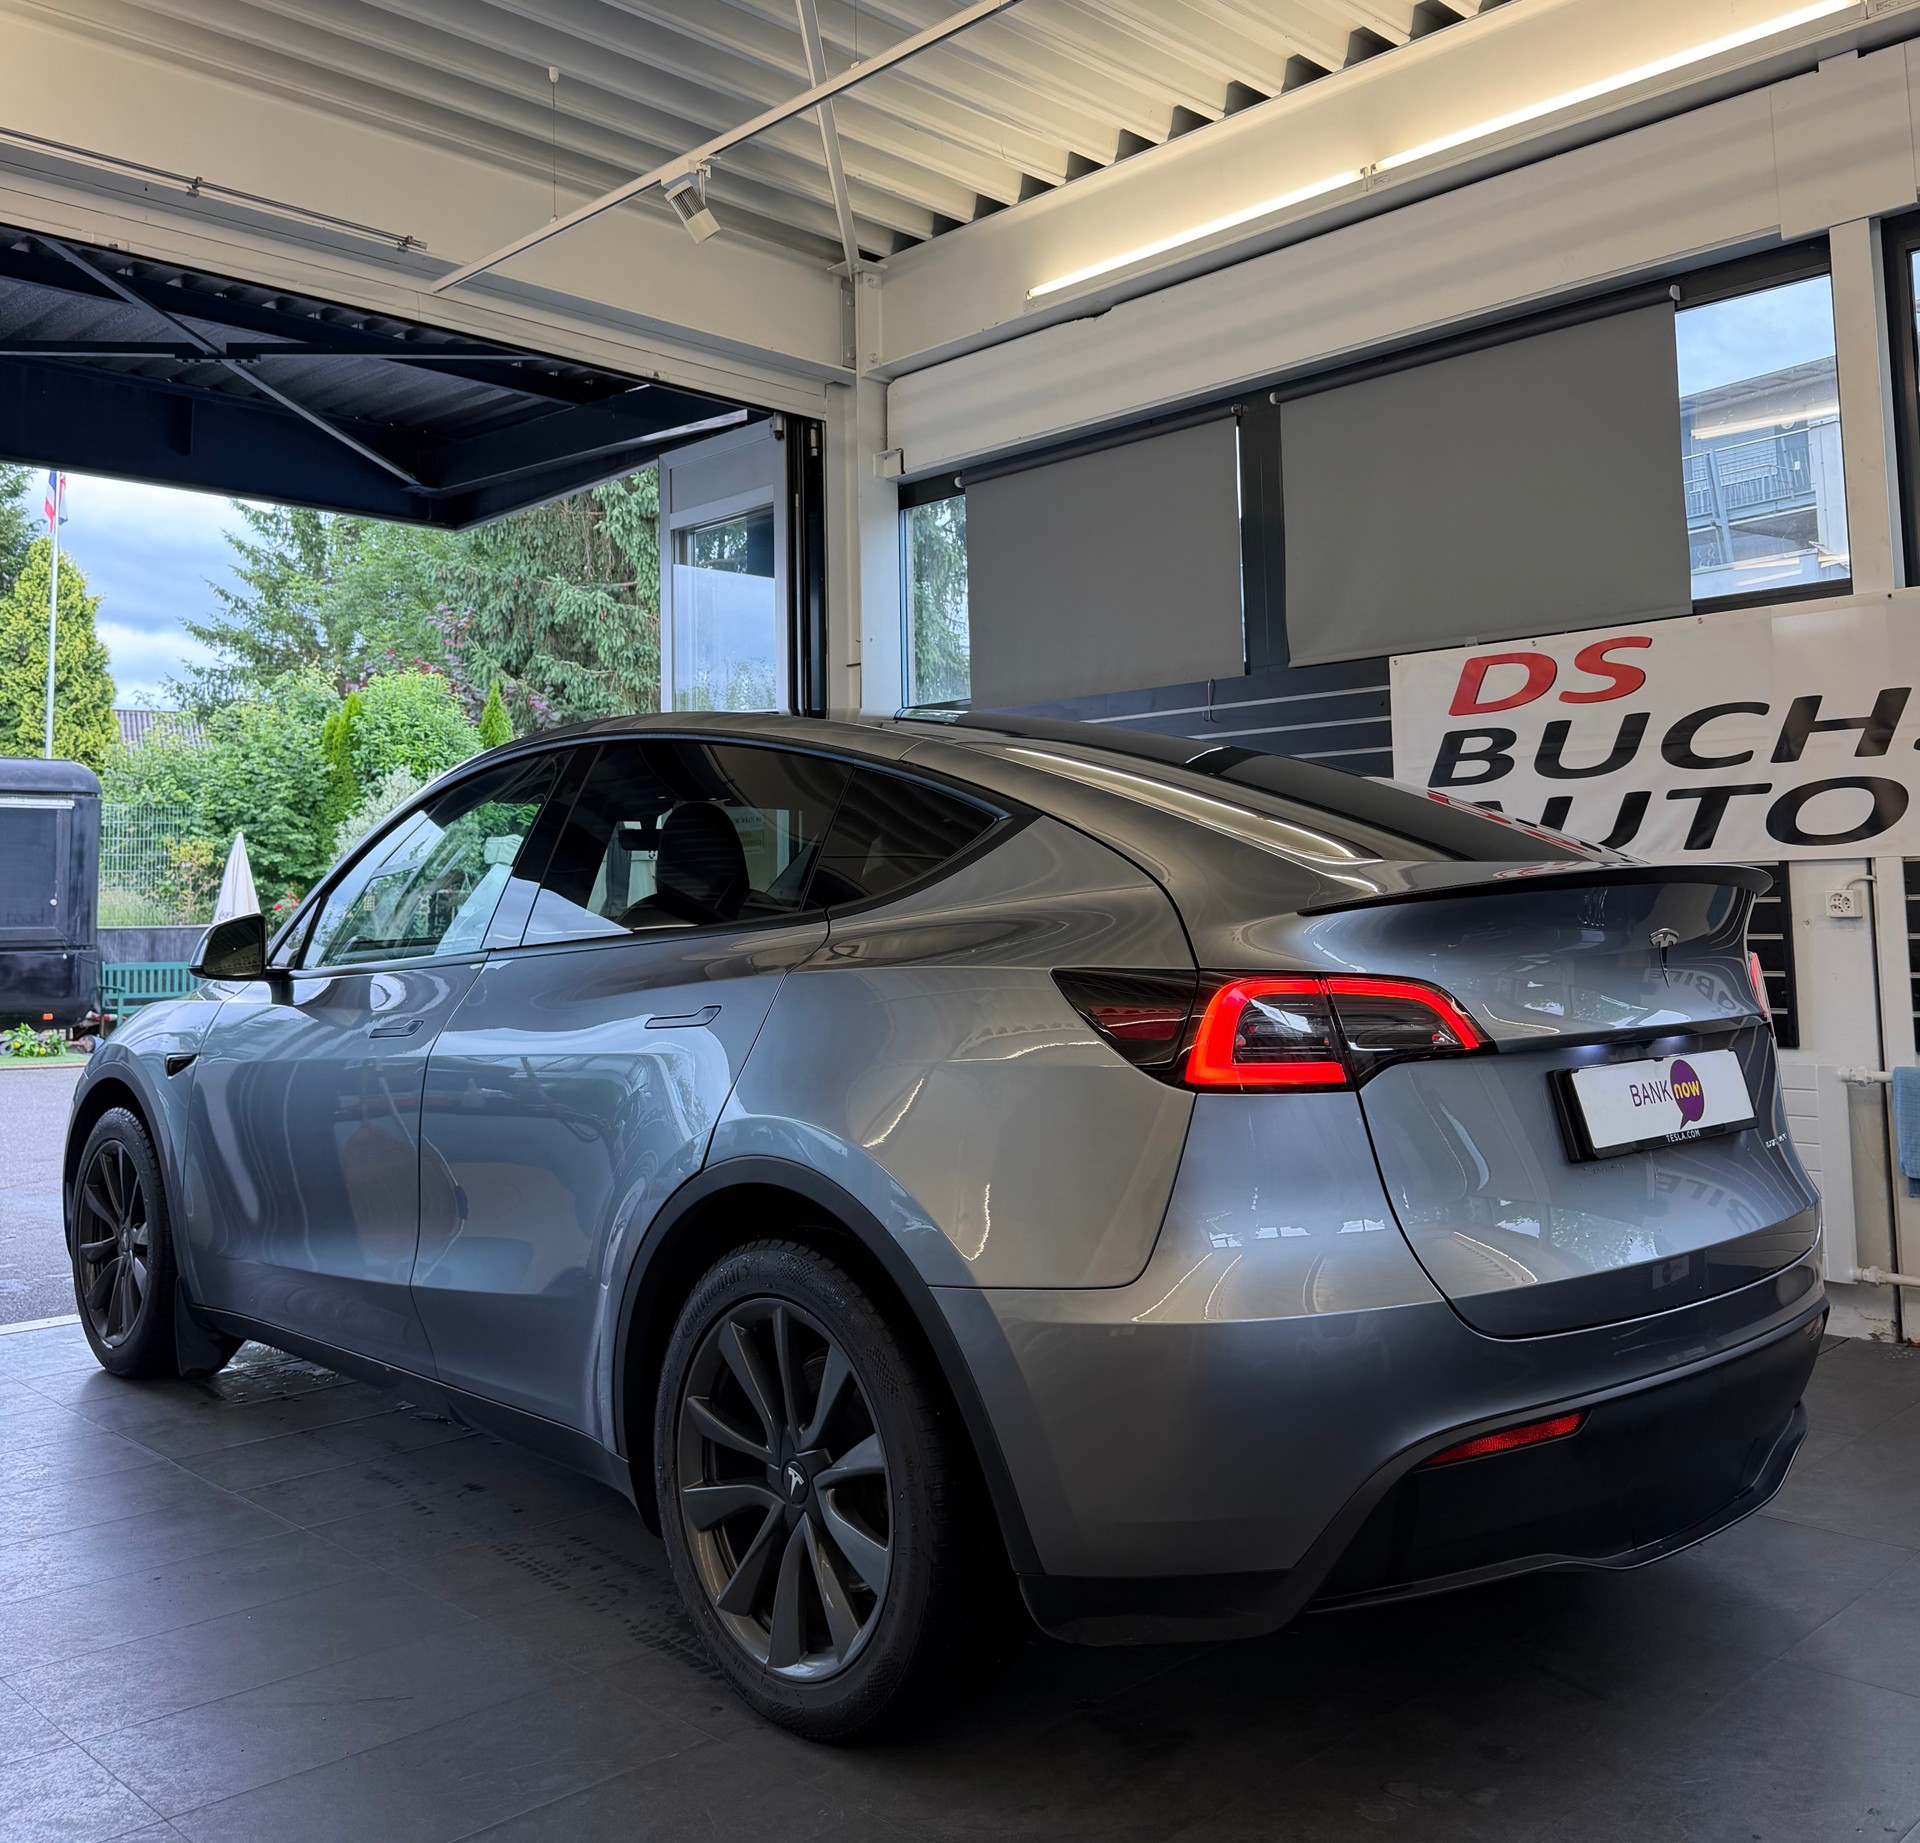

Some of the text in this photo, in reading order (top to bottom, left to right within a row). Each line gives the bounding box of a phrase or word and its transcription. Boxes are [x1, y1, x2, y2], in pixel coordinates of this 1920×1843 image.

[1448, 636, 1653, 716] DS
[1428, 687, 1920, 787] BUCH
[1474, 776, 1909, 851] UTO
[1629, 1080, 1700, 1107] BANK now
[1666, 1129, 1701, 1142] TESLA.COM
